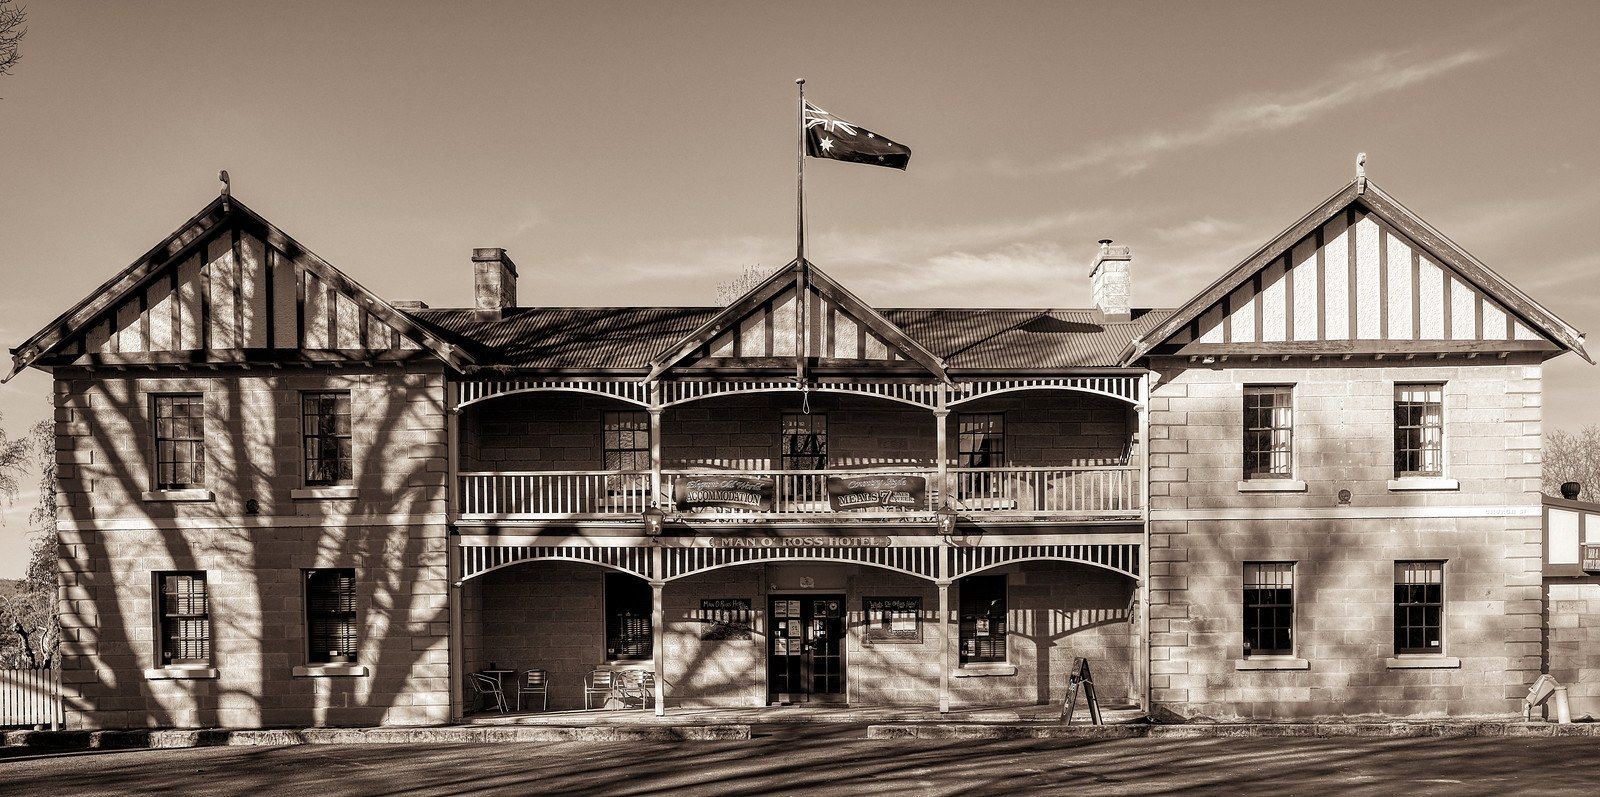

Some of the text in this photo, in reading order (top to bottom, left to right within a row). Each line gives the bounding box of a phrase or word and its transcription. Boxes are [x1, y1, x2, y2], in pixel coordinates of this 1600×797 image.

[736, 480, 765, 491] World
[685, 490, 762, 506] ACCOMMODATION
[837, 489, 892, 506] MEALS 7
[721, 537, 756, 547] MAN
[782, 537, 823, 547] ROSS
[829, 537, 879, 546] HOTEL
